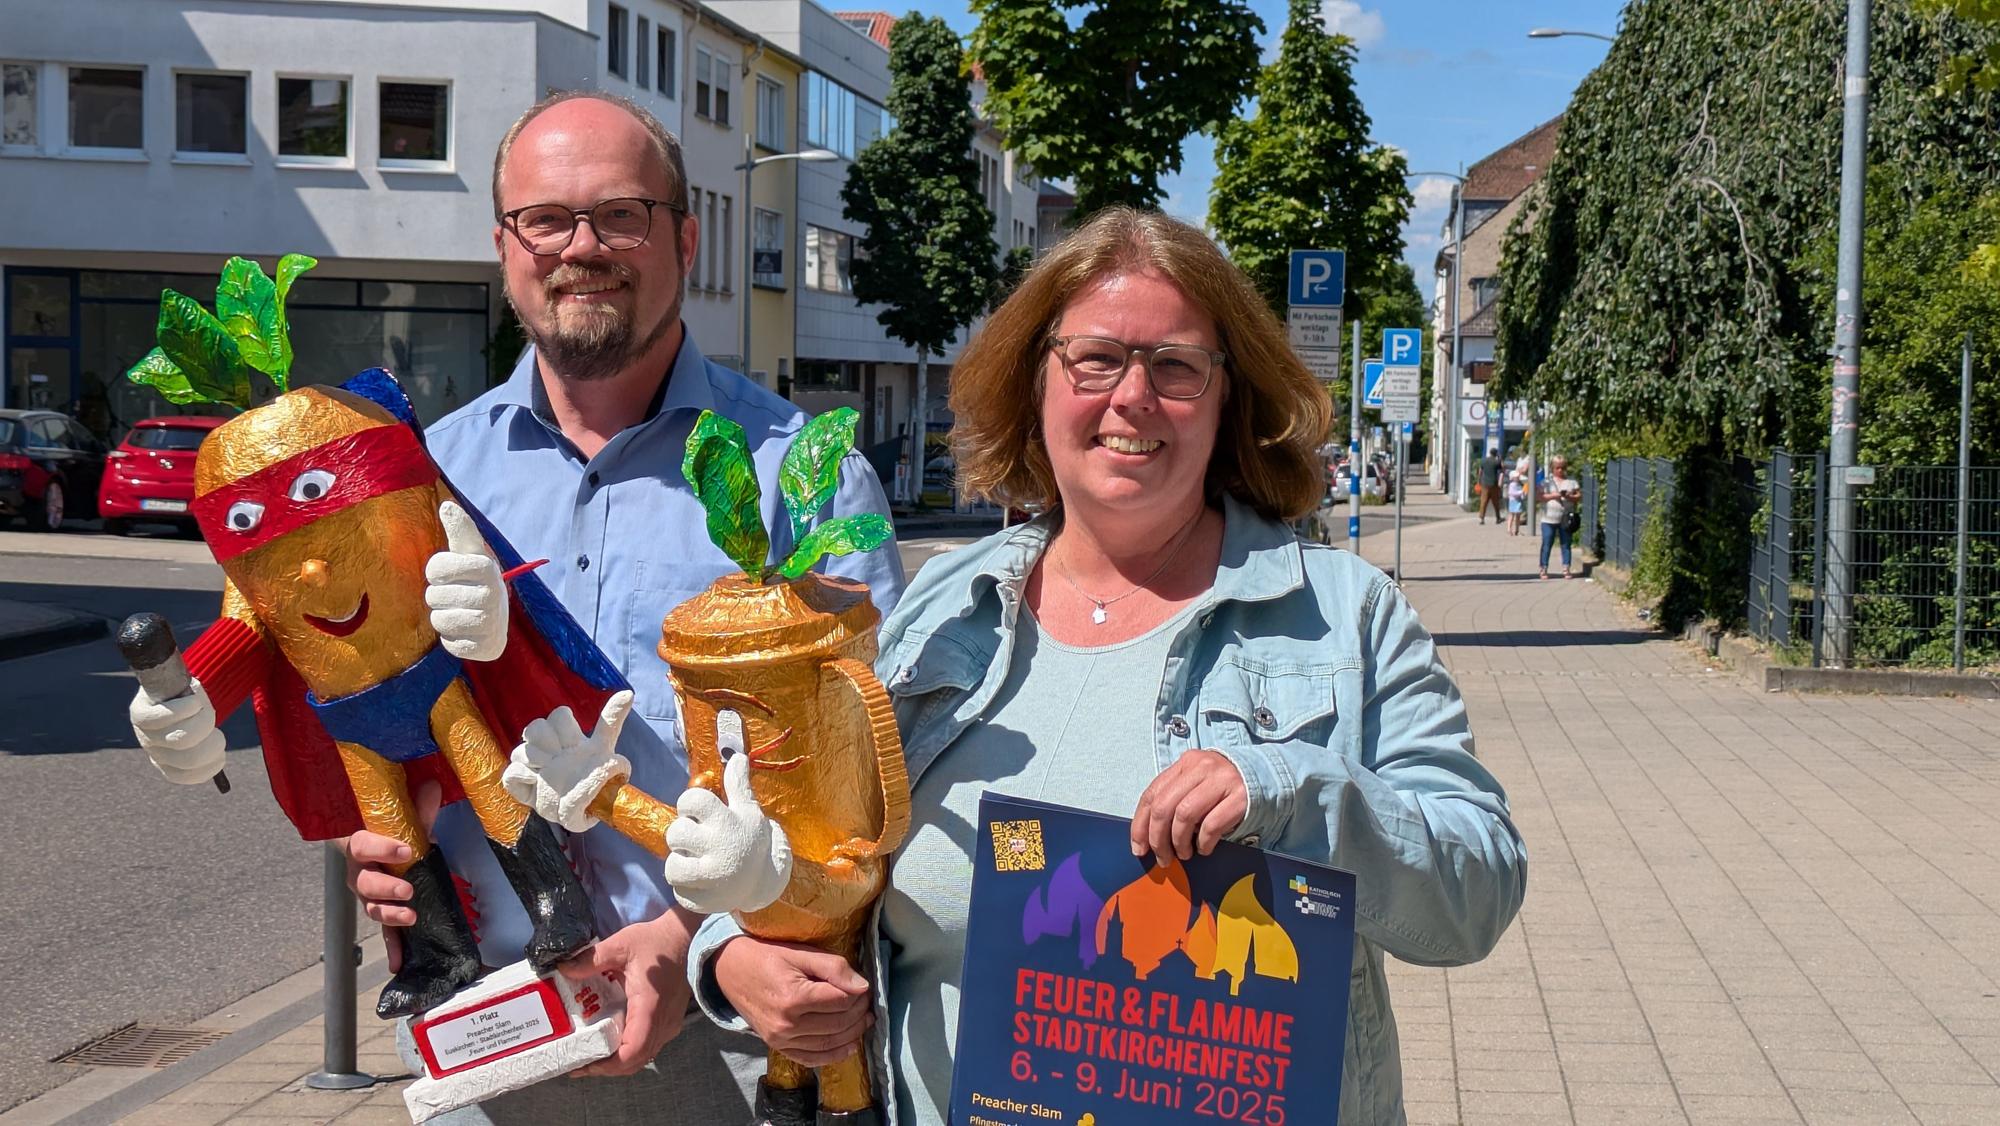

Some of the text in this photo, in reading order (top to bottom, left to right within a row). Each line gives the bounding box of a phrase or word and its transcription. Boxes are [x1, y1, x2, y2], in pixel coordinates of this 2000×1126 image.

[1302, 257, 1332, 299] P
[1392, 334, 1413, 362] P
[470, 1011, 500, 1026] 1. Platz
[1015, 968, 1295, 1054] FEUER & FLAMME
[444, 1040, 476, 1055] Euskirchen
[479, 1024, 525, 1043] Stadtkirchenfest
[466, 1019, 512, 1039] Preacher Slam
[486, 1041, 498, 1049] und
[1012, 1011, 1291, 1091] STADTKIRCHENFEST
[1010, 1050, 1039, 1083] 6.
[1076, 1062, 1102, 1095] 9.
[1113, 1068, 1183, 1109] Juni
[1194, 1082, 1286, 1126] 2025
[971, 1092, 1062, 1120] Preacher Slam
